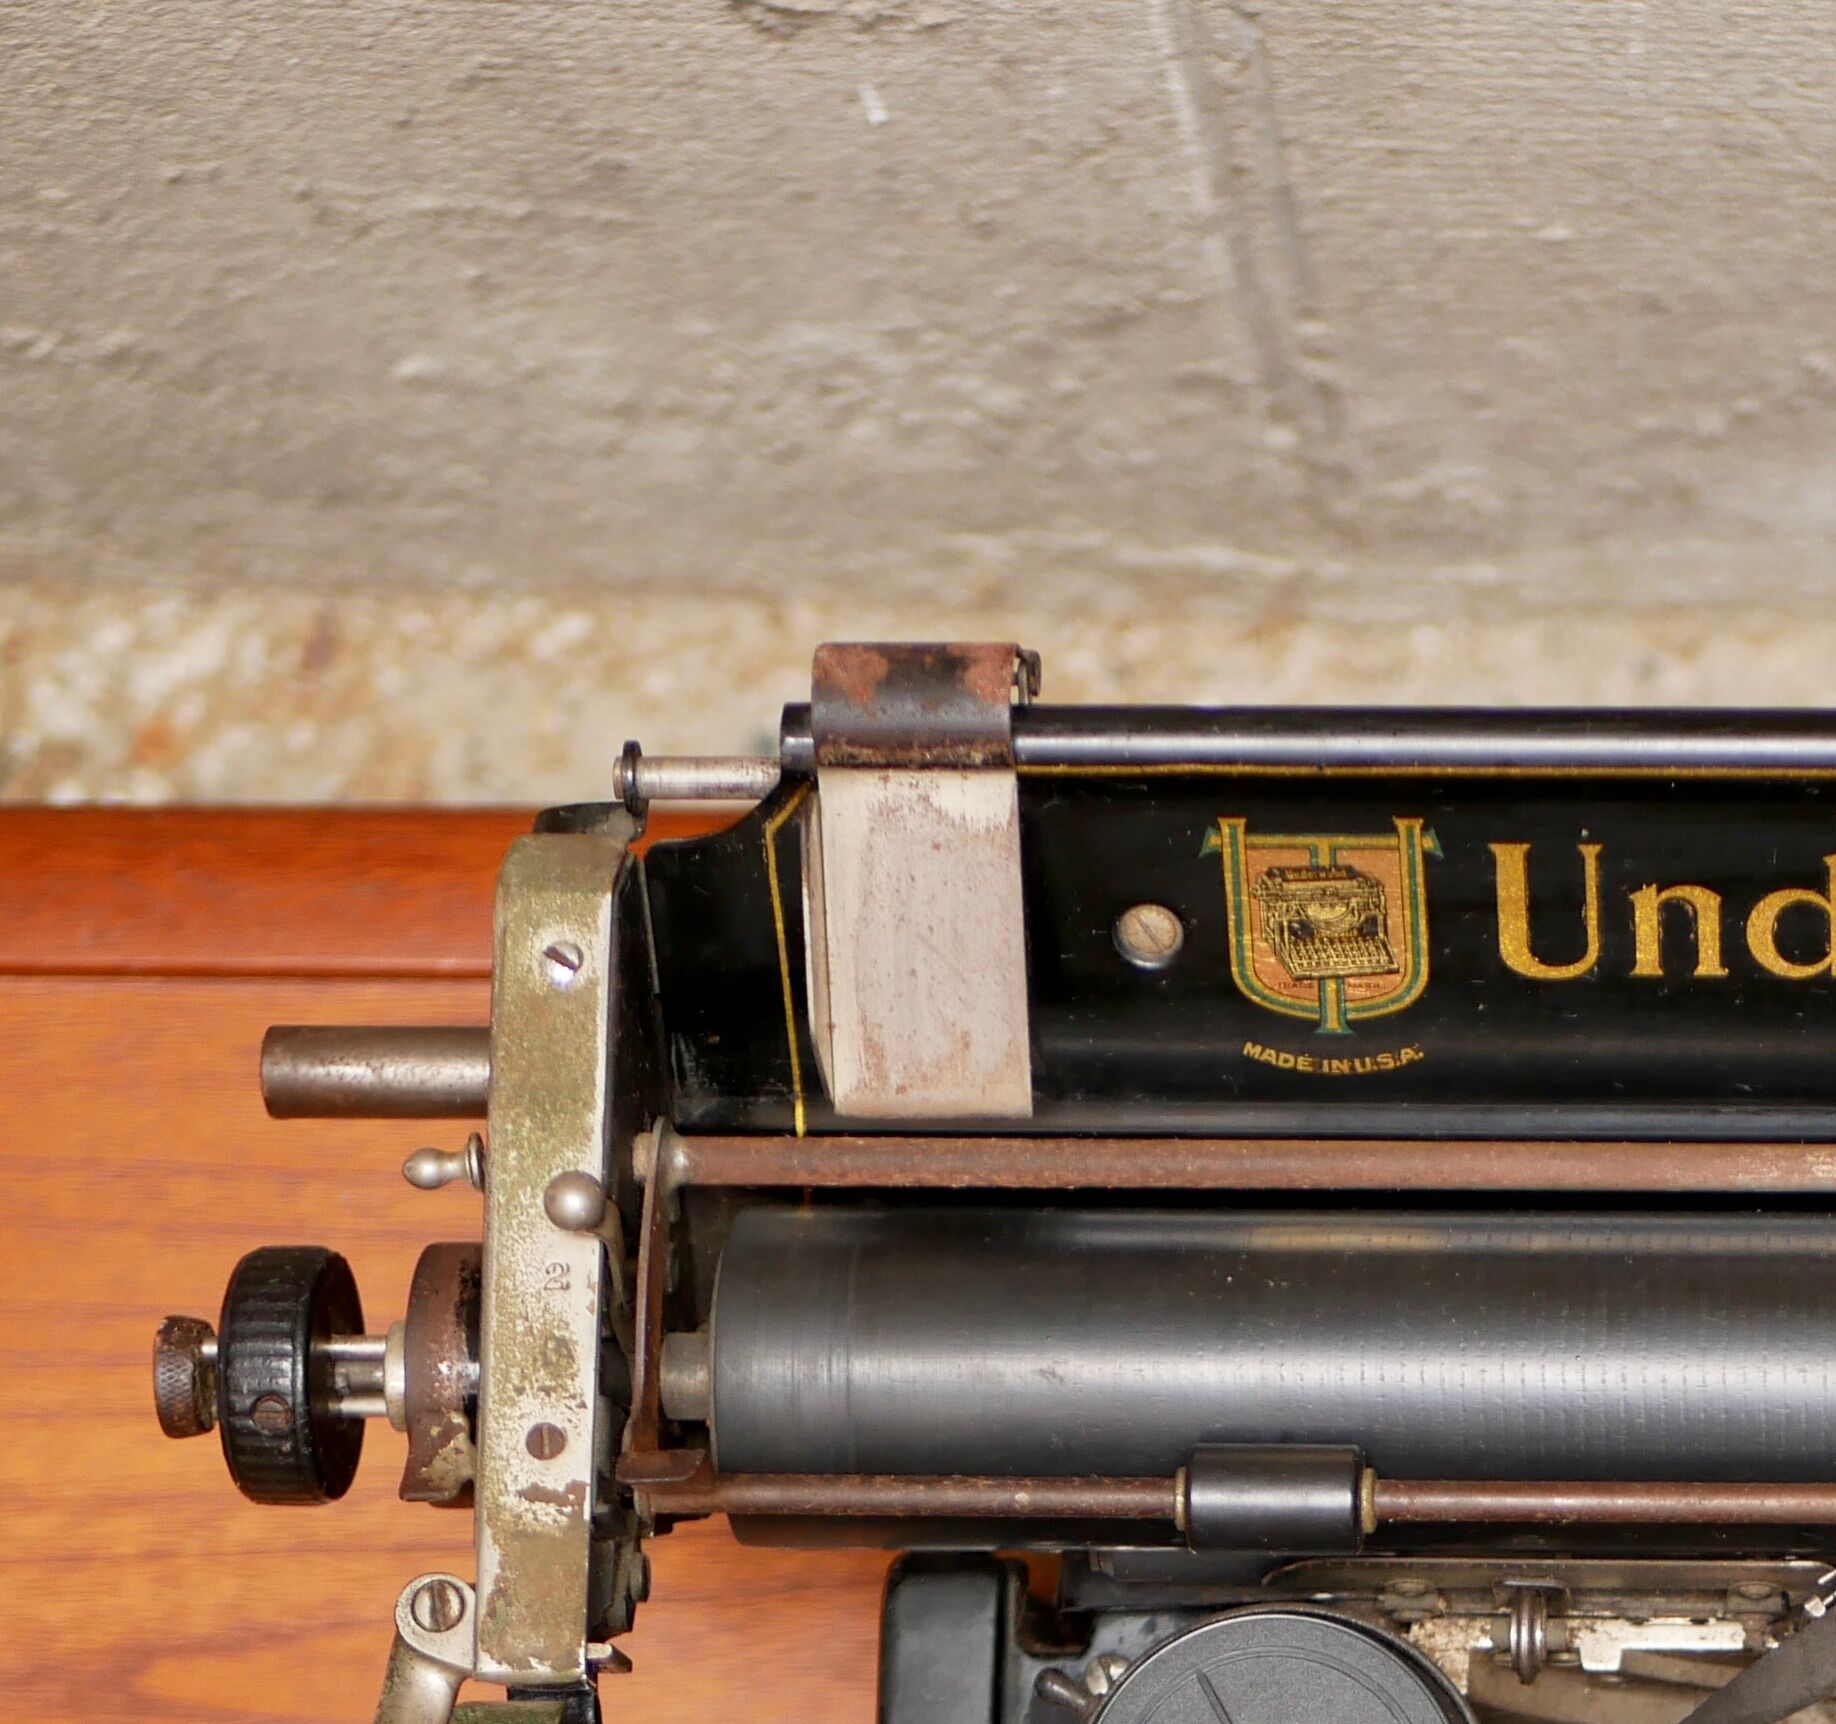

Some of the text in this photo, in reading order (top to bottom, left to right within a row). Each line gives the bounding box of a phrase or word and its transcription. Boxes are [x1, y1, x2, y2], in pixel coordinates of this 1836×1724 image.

[1243, 1041, 1424, 1073] MADE IN U.S.A.
